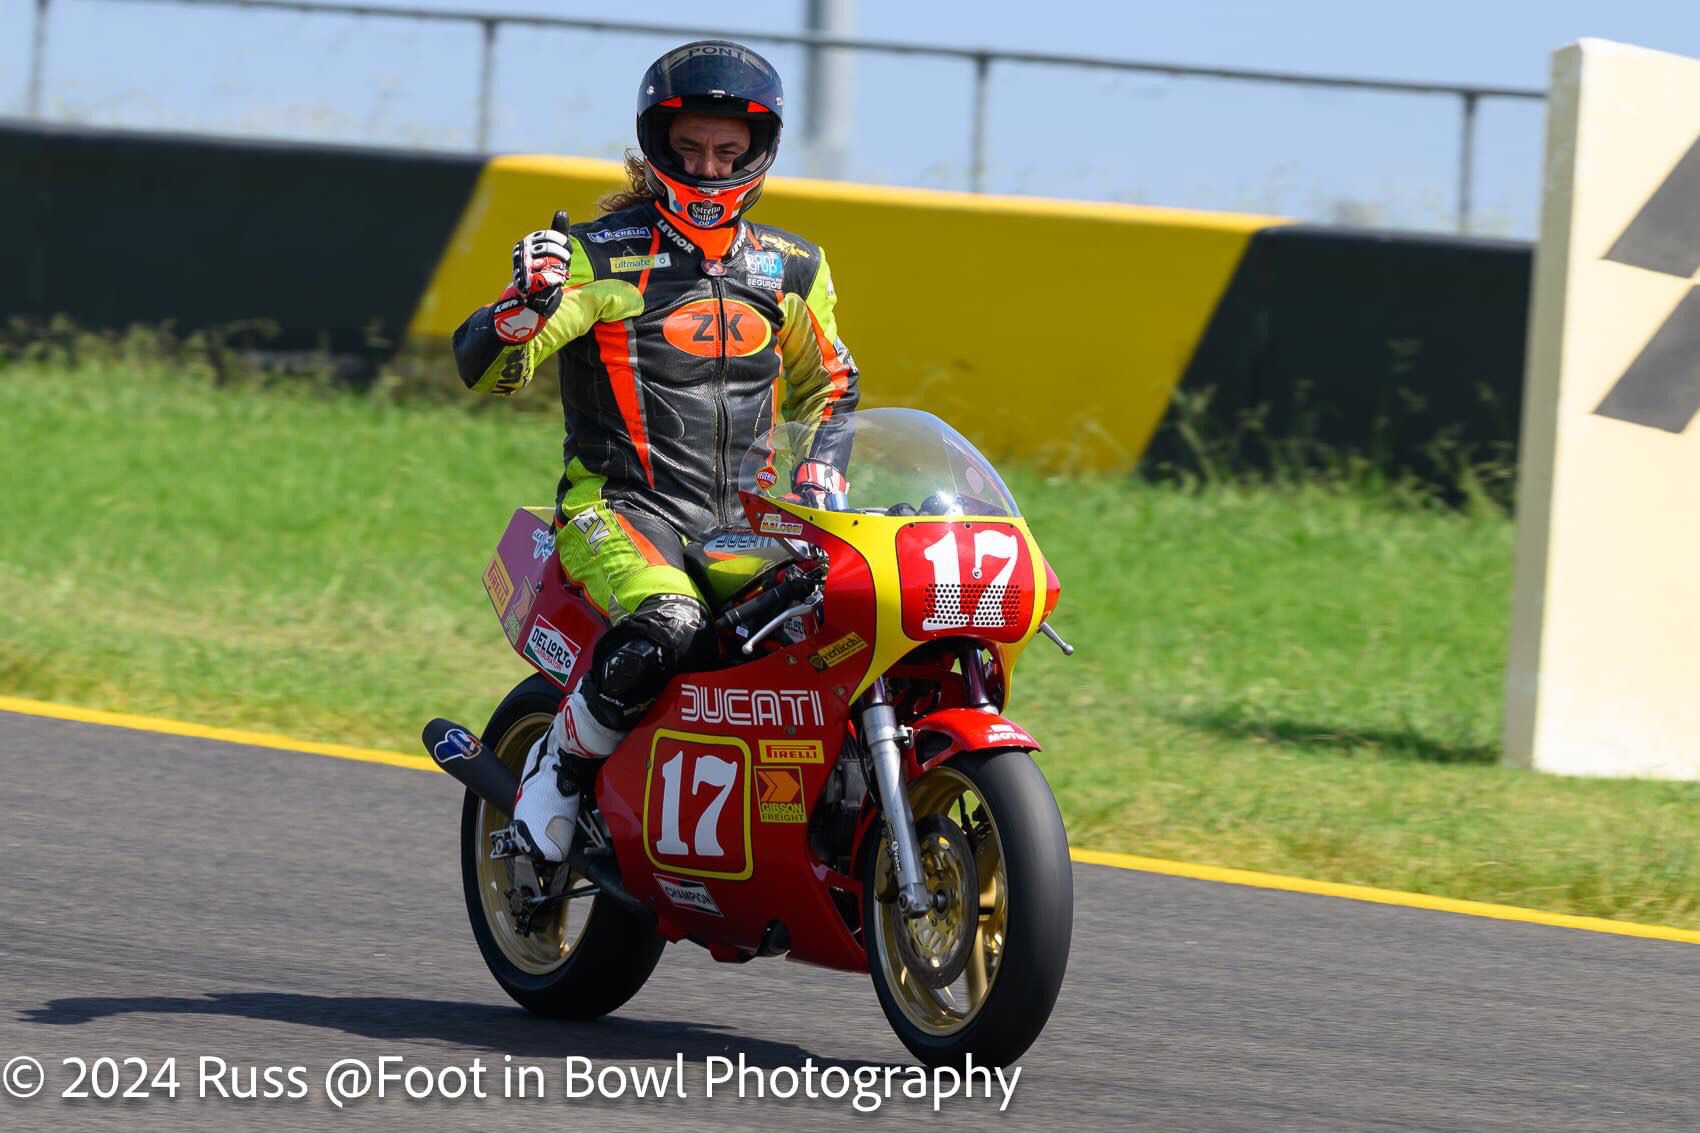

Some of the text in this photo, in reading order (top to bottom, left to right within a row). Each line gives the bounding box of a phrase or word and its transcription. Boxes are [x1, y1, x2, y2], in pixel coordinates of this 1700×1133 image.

[604, 228, 647, 239] MICHELIN
[657, 220, 695, 253] LEVIOR
[614, 259, 650, 270] ultimate
[747, 278, 782, 290] SEGUROS
[715, 532, 772, 548] DUCATI
[488, 560, 510, 608] PIRELLI
[922, 530, 1019, 631] 17
[532, 628, 572, 669] DELLORTO
[681, 684, 825, 727] DUCATI
[766, 744, 817, 759] PIRELLI
[656, 750, 738, 857] 17
[761, 803, 803, 814] GIBSON
[762, 814, 804, 822] FREIGHT
[665, 886, 712, 905] CHAMPION
